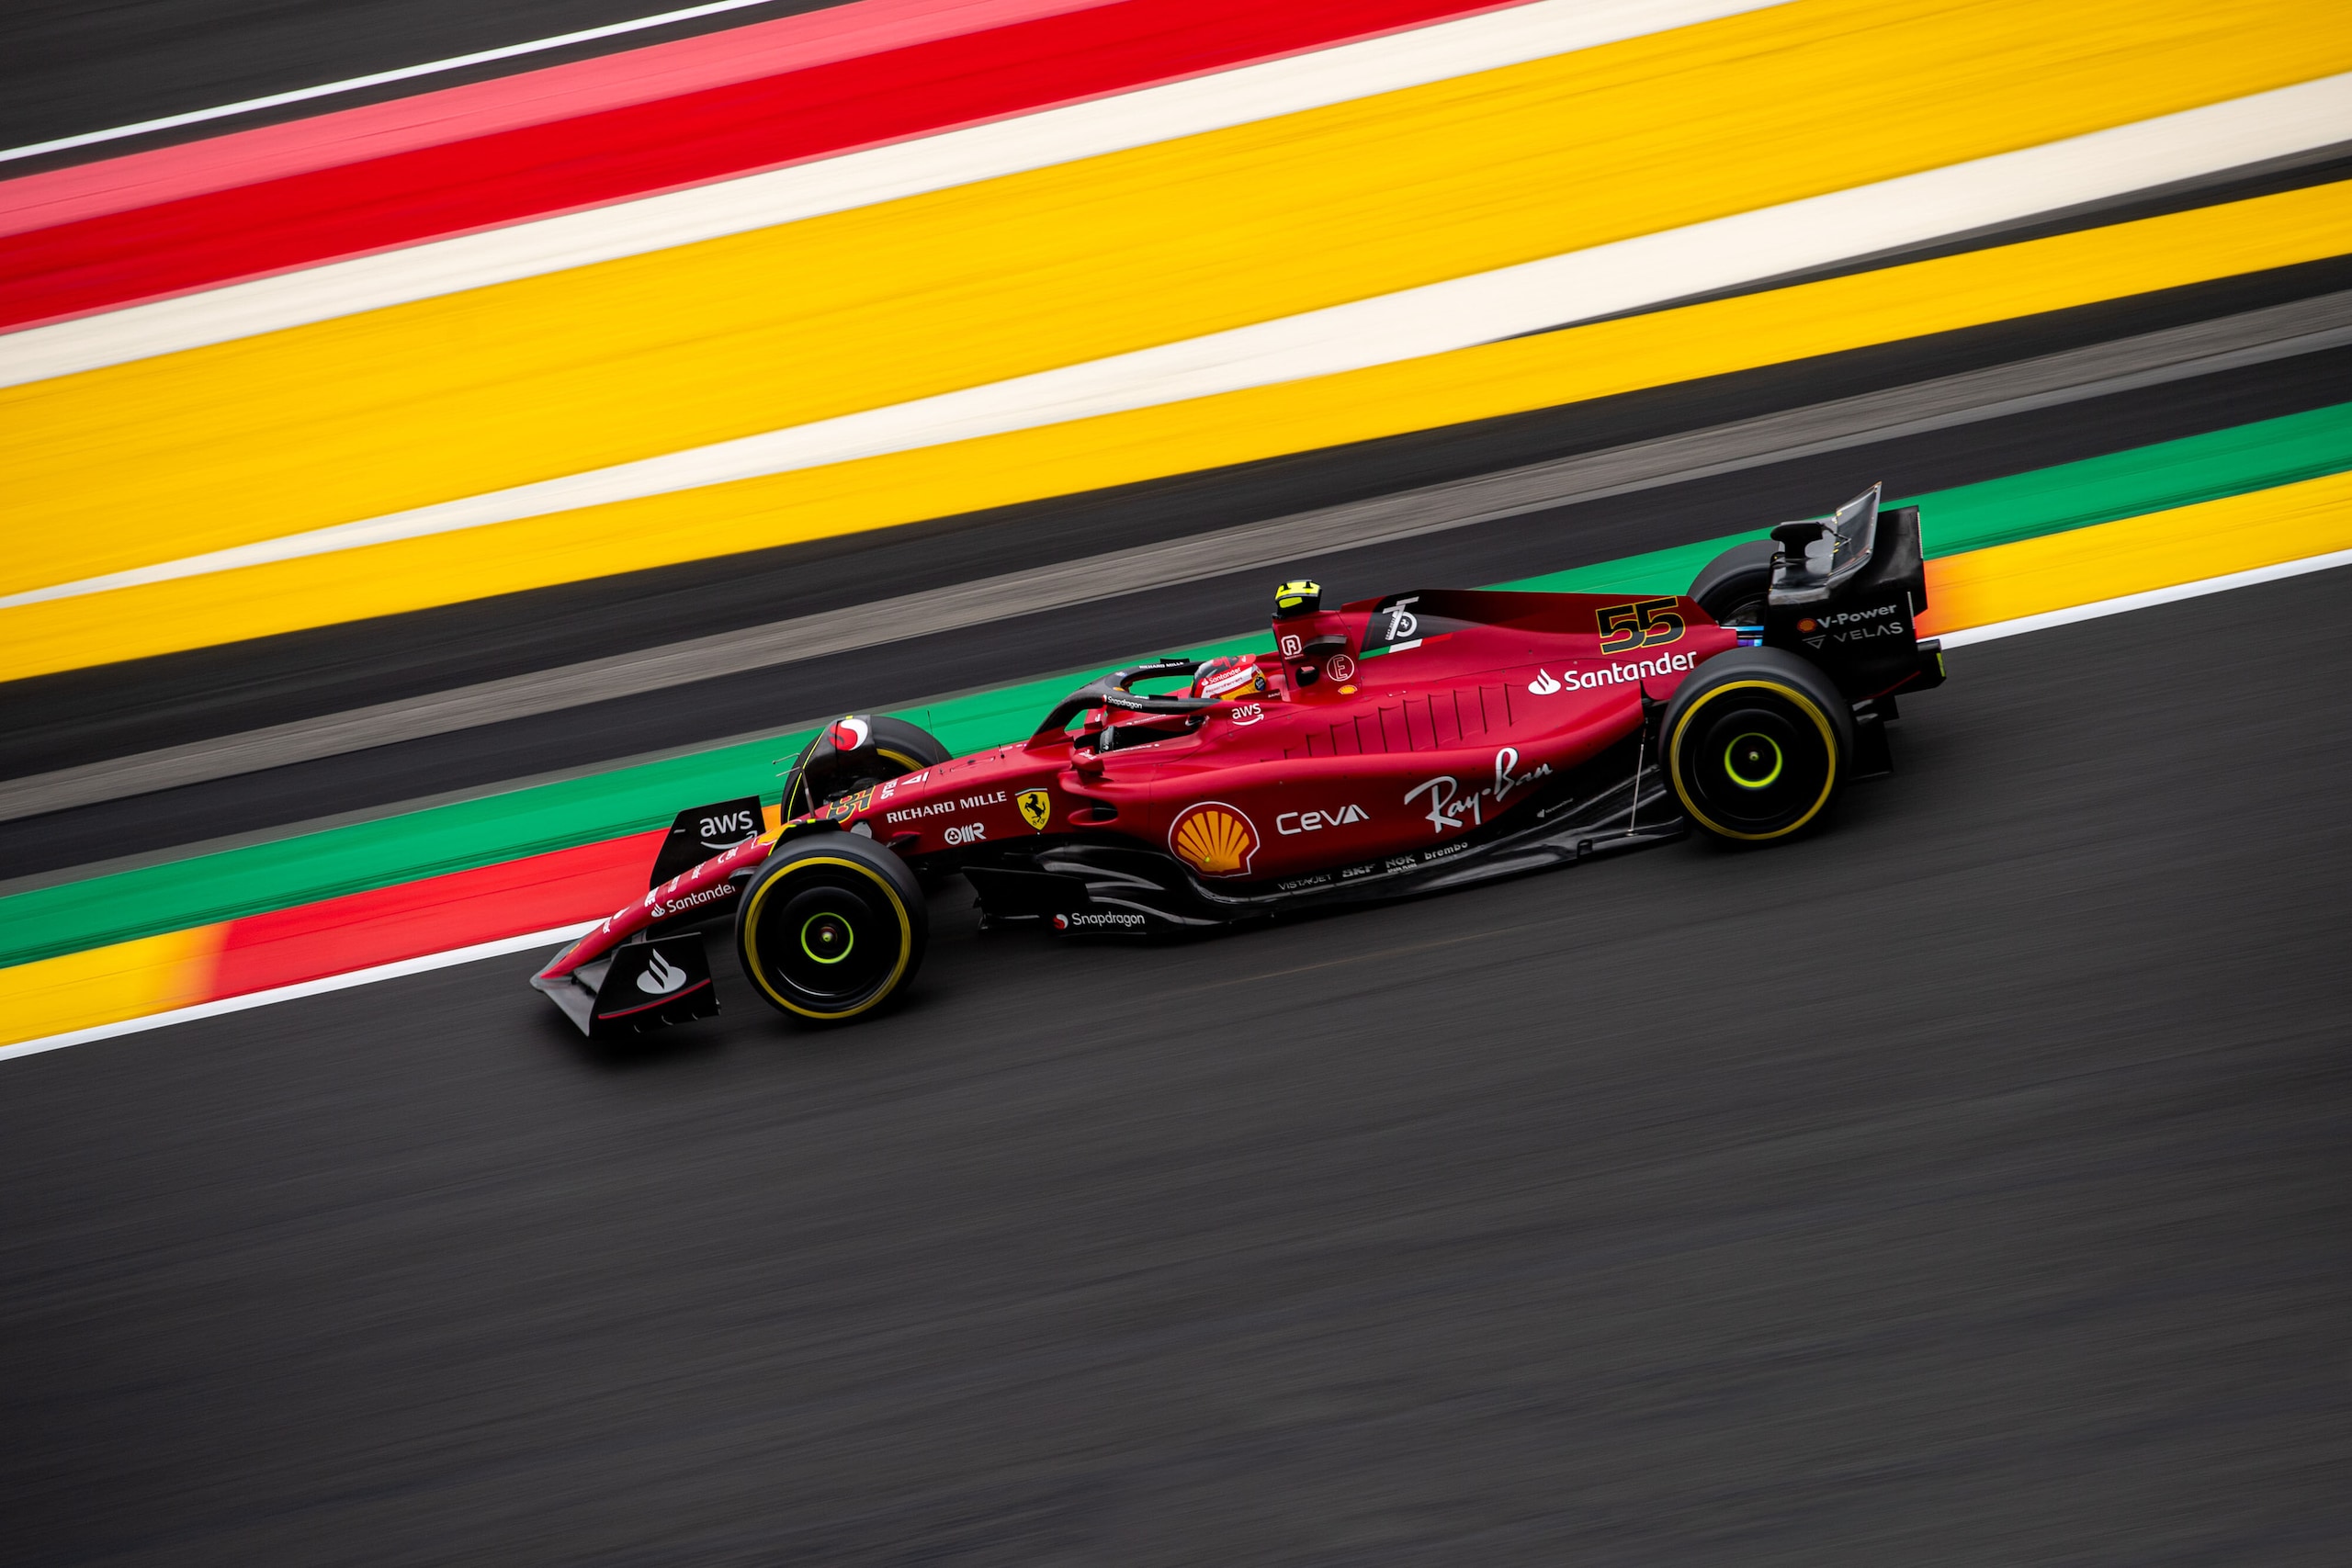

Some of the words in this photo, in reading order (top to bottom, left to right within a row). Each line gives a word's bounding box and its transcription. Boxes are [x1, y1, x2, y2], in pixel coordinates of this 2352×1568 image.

[1595, 594, 1686, 655] 55
[1817, 604, 1897, 628] V-Power
[1833, 622, 1904, 643] VELAS
[1208, 667, 1241, 684] Santander
[1564, 651, 1697, 692] Santander
[1107, 695, 1143, 709] Snapdragon
[1231, 703, 1261, 719] aws
[1404, 747, 1553, 833] Ray-Ban
[886, 800, 956, 824] RICHARD
[959, 791, 1007, 809] MILLE
[699, 810, 753, 838] aws
[1424, 841, 1468, 860] brembo
[1385, 854, 1417, 869] NGK
[1071, 911, 1145, 928] Snapdragon
